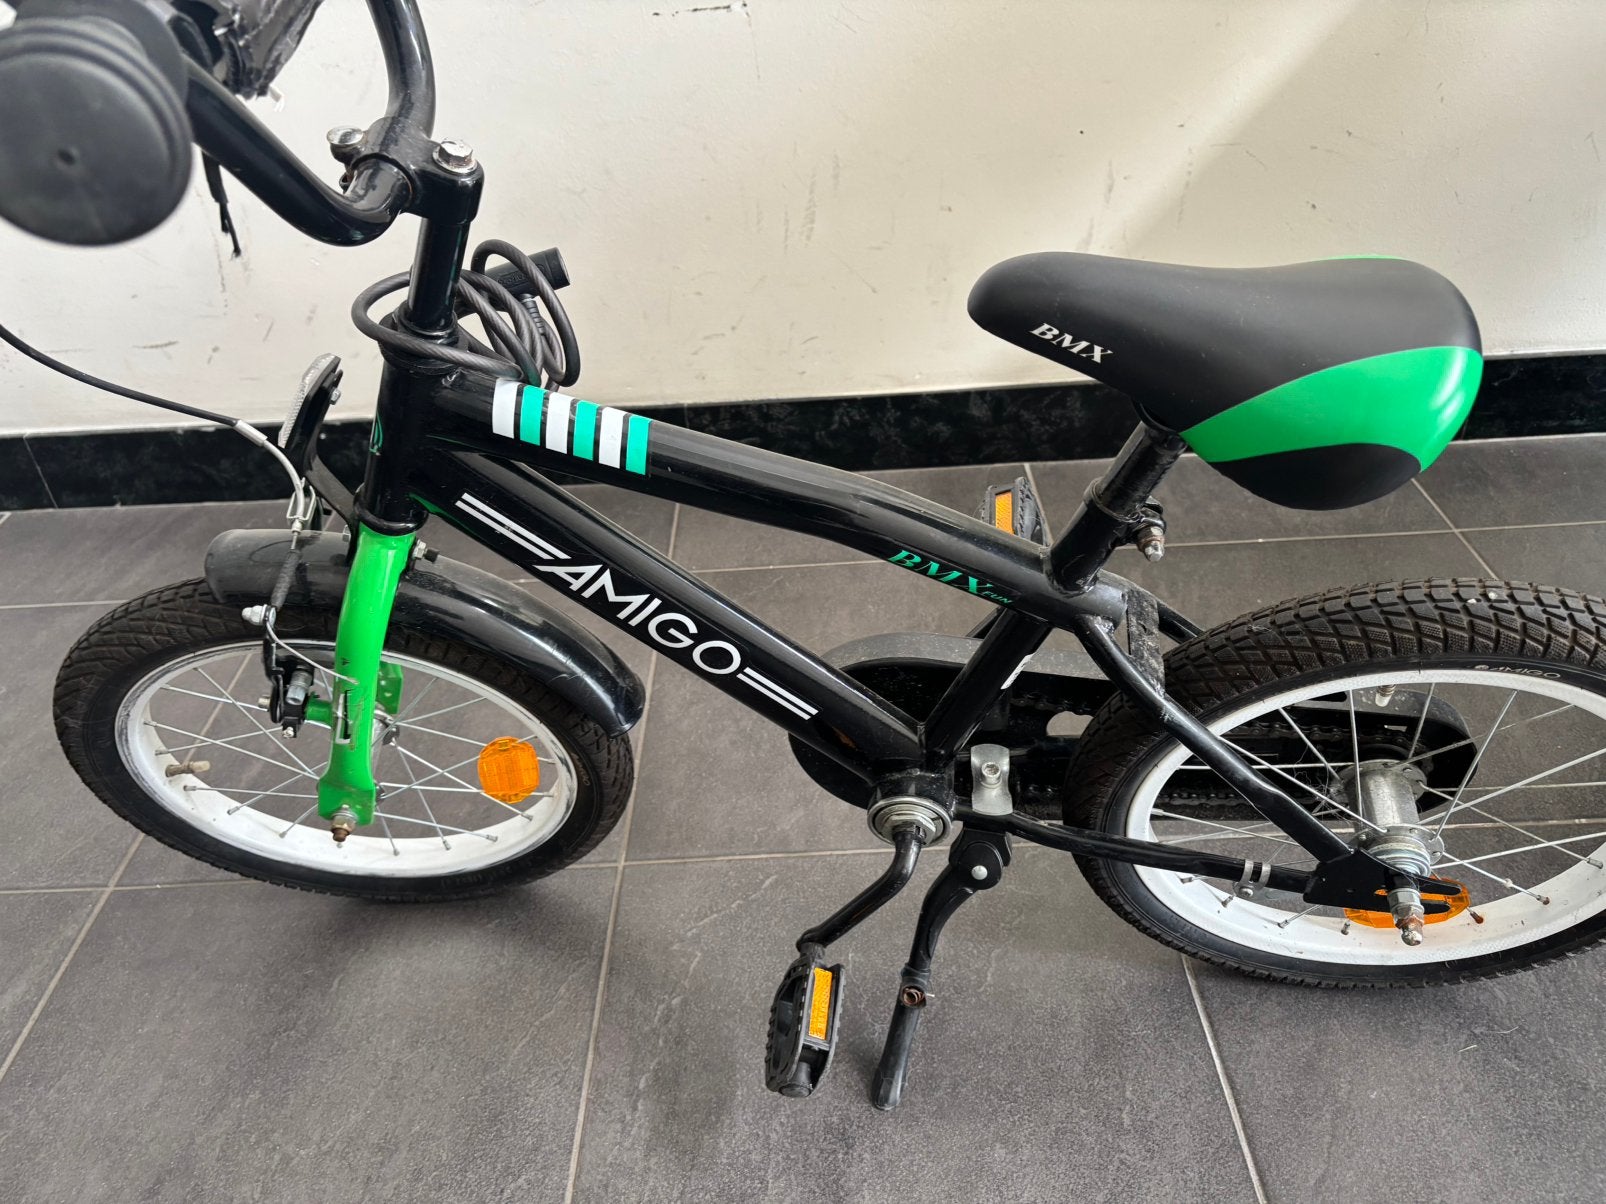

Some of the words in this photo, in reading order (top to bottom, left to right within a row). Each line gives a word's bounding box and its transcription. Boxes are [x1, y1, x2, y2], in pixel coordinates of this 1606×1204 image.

[1028, 322, 1114, 364] BMX
[887, 549, 993, 594] BMX
[533, 563, 742, 676] AMIGO
[1490, 666, 1561, 679] AMIGO
